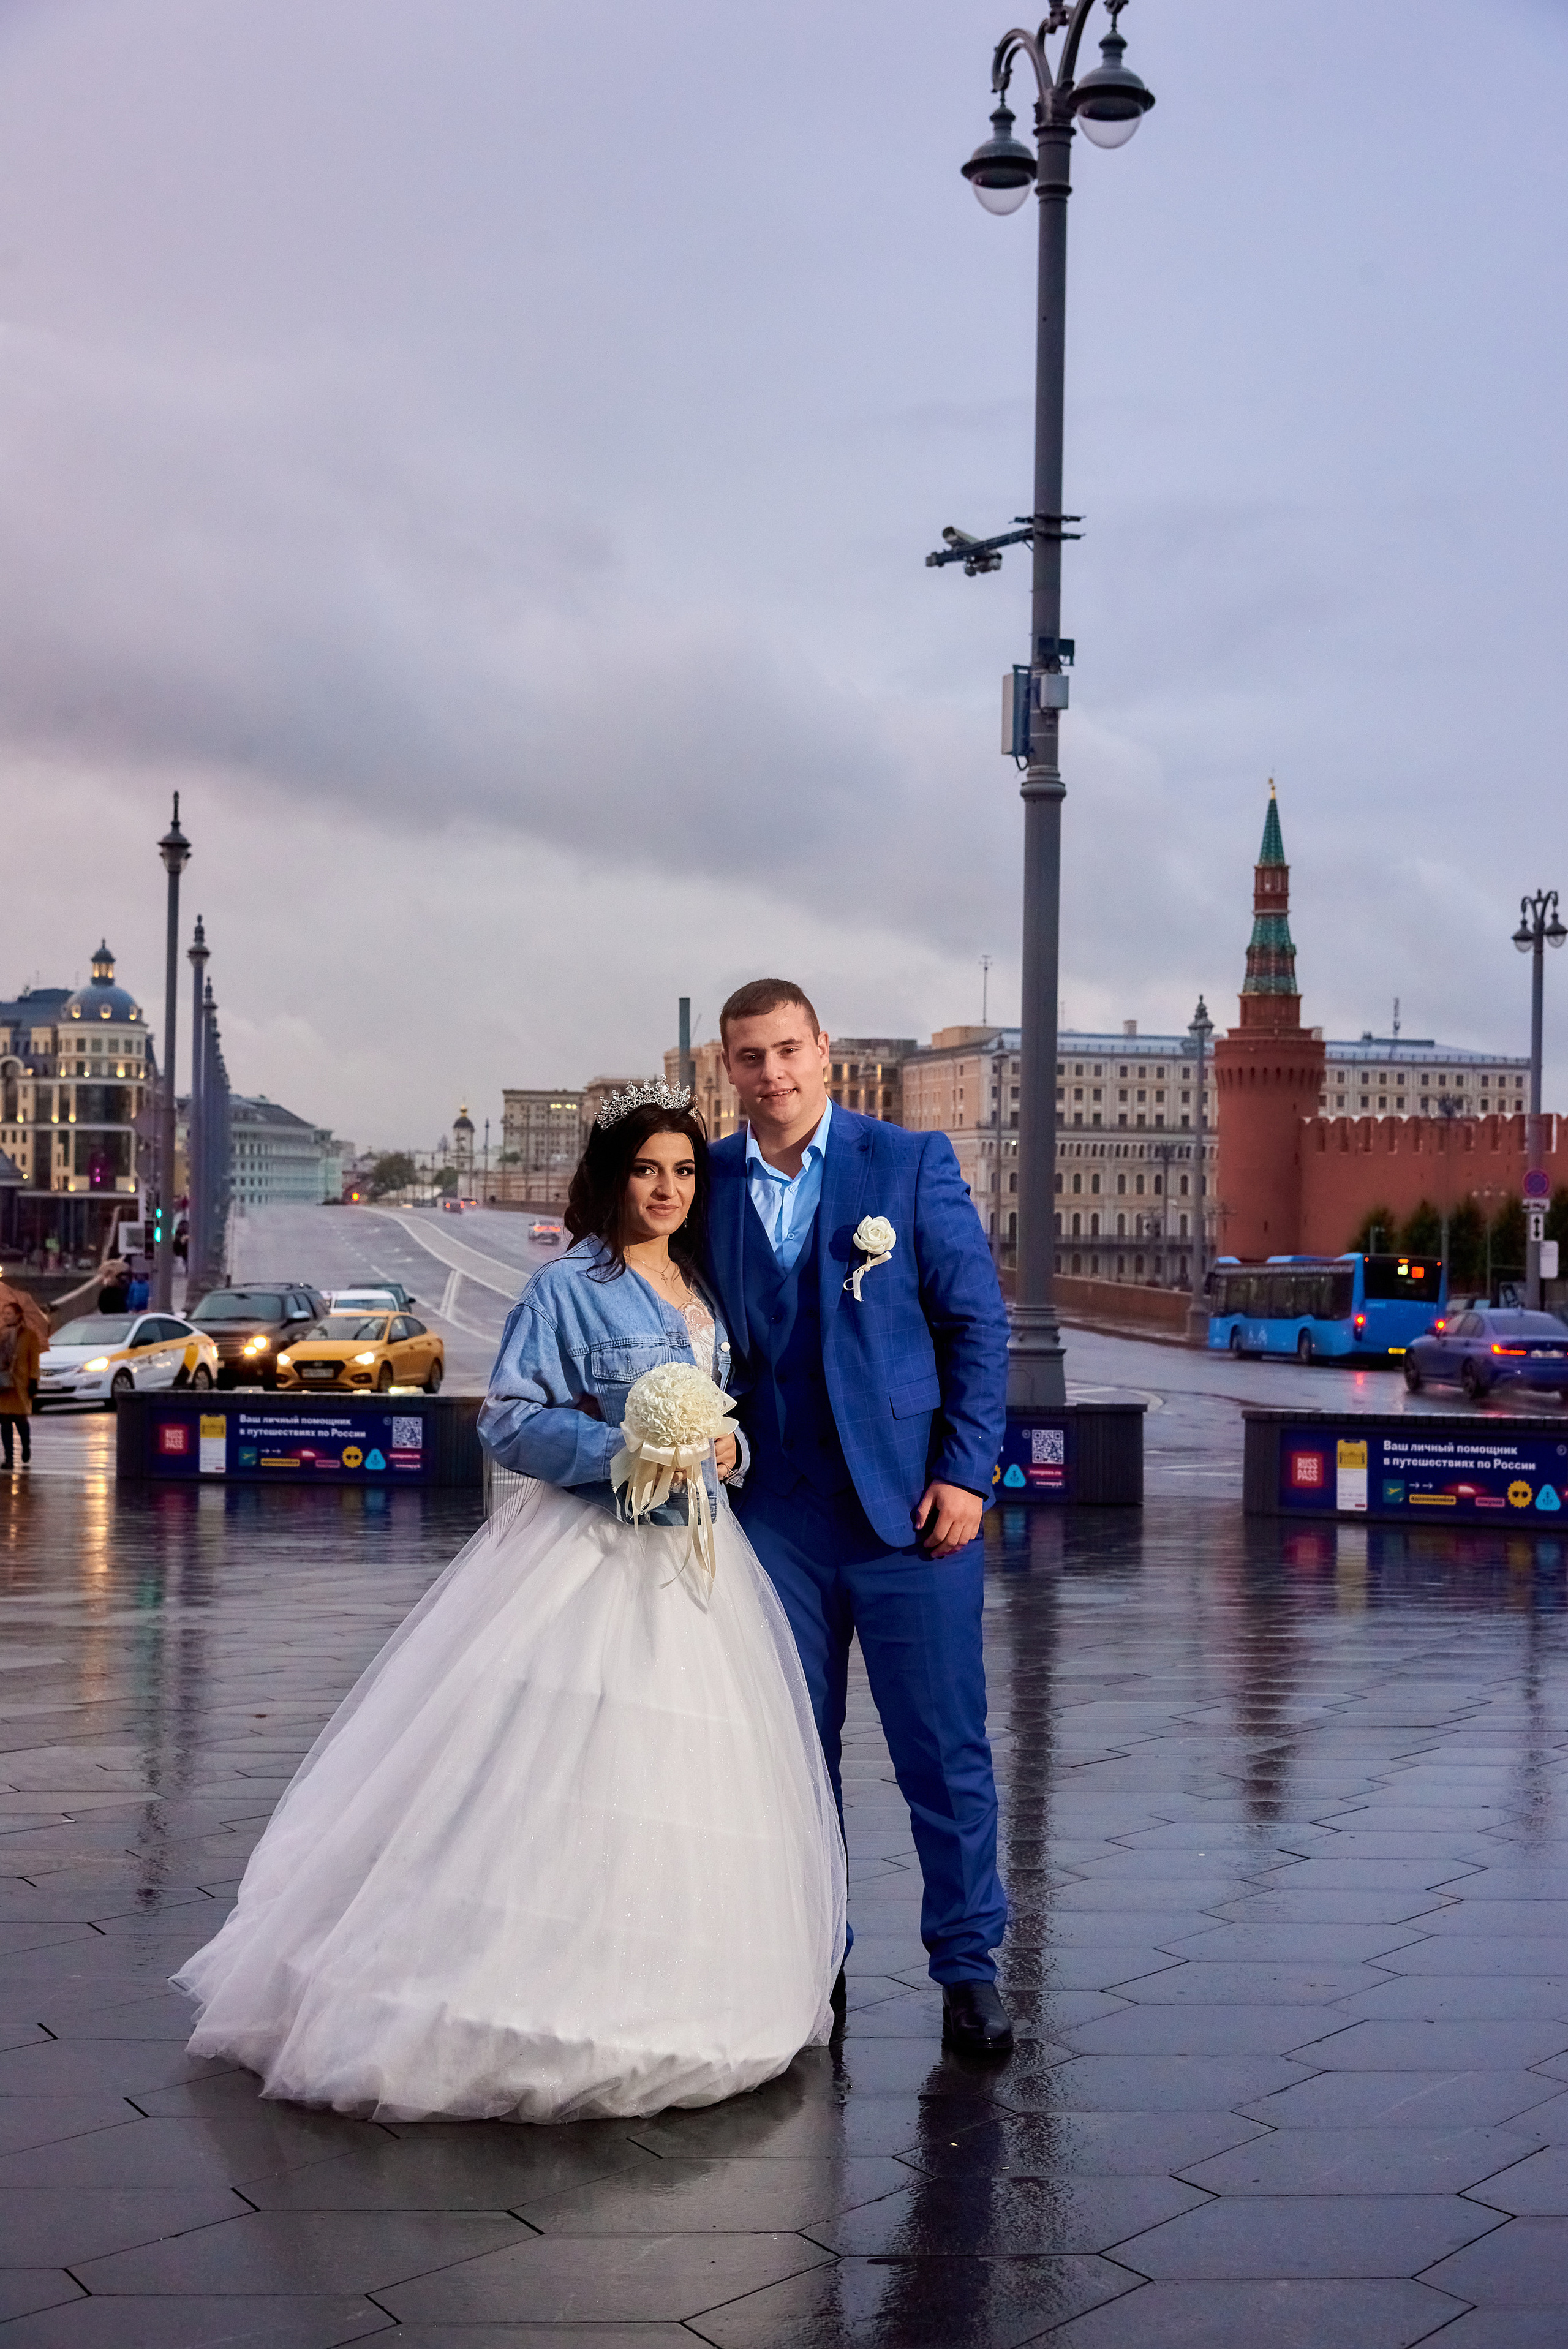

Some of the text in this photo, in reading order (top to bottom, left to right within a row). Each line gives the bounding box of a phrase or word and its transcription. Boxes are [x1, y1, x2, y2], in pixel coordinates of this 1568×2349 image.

[239, 1414, 352, 1426] Ваш личный помощник
[247, 1428, 315, 1438] путешествиях
[331, 1428, 366, 1438] России
[1383, 1440, 1518, 1455] Ваш личный помощник
[1297, 1458, 1317, 1469] RUSS
[1392, 1458, 1475, 1468] путешествиях
[1477, 1460, 1491, 1469] по
[1493, 1458, 1536, 1471] России
[1297, 1469, 1317, 1482] PASS
